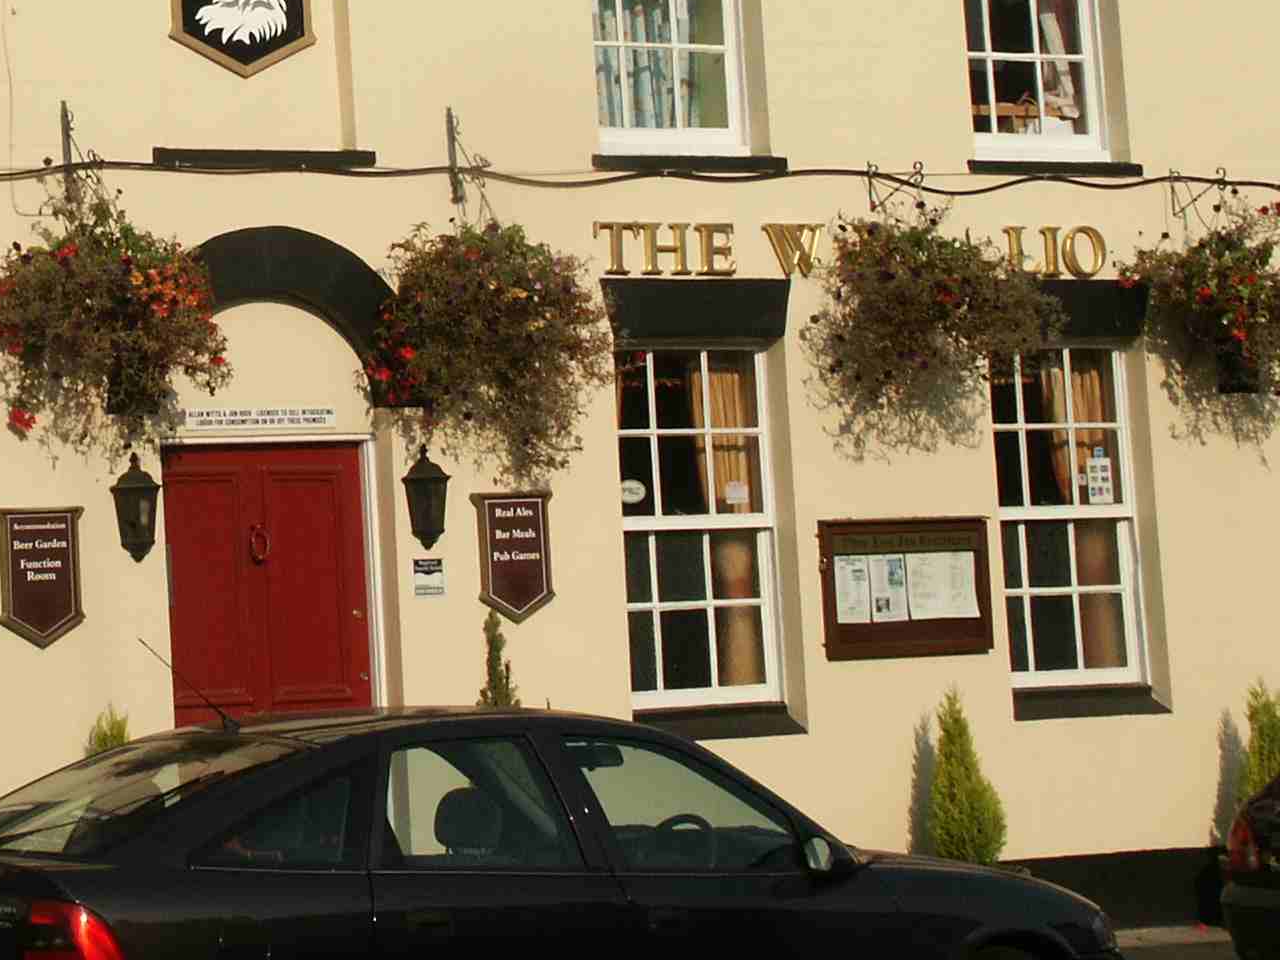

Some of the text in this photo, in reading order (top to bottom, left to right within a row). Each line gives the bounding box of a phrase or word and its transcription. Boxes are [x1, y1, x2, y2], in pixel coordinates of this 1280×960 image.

[592, 220, 737, 277] THE
[1001, 225, 1108, 280] LIO
[495, 507, 534, 518] Real Ales
[495, 528, 537, 540] Bar Meals
[13, 538, 68, 550] Beer Garden
[493, 551, 541, 561] Pub Games
[20, 558, 62, 569] Function
[27, 571, 57, 582] Room
